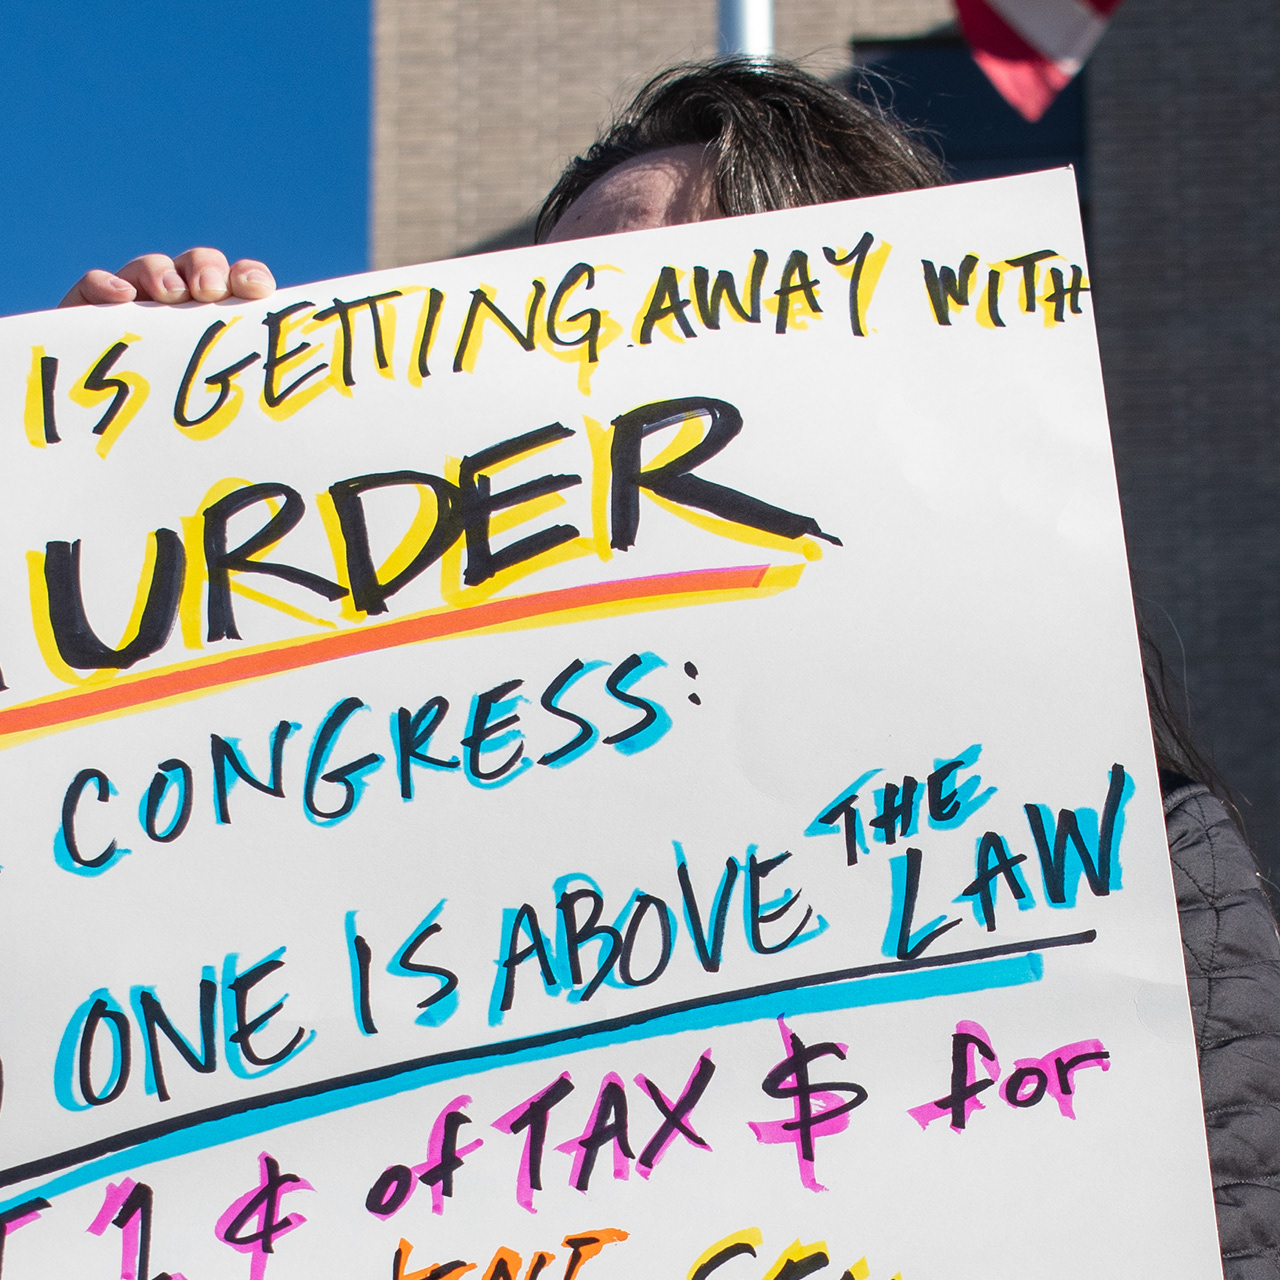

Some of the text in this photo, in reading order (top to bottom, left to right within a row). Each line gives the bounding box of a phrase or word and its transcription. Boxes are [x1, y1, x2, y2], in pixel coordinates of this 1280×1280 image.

[25, 332, 150, 458] IS
[172, 262, 614, 440] GETTING
[636, 232, 890, 344] AWAY
[921, 248, 1091, 330] WITH
[54, 652, 701, 877] CONGRESS:
[806, 744, 997, 866] THE
[489, 841, 829, 1025] ABOVE
[882, 762, 1134, 961] LAW
[54, 947, 317, 1111] ONE
[345, 899, 460, 1034] IS
[365, 1096, 482, 1218] of
[493, 1049, 716, 1213] TAX
[754, 1018, 868, 1180] $
[913, 1022, 1111, 1134] for
